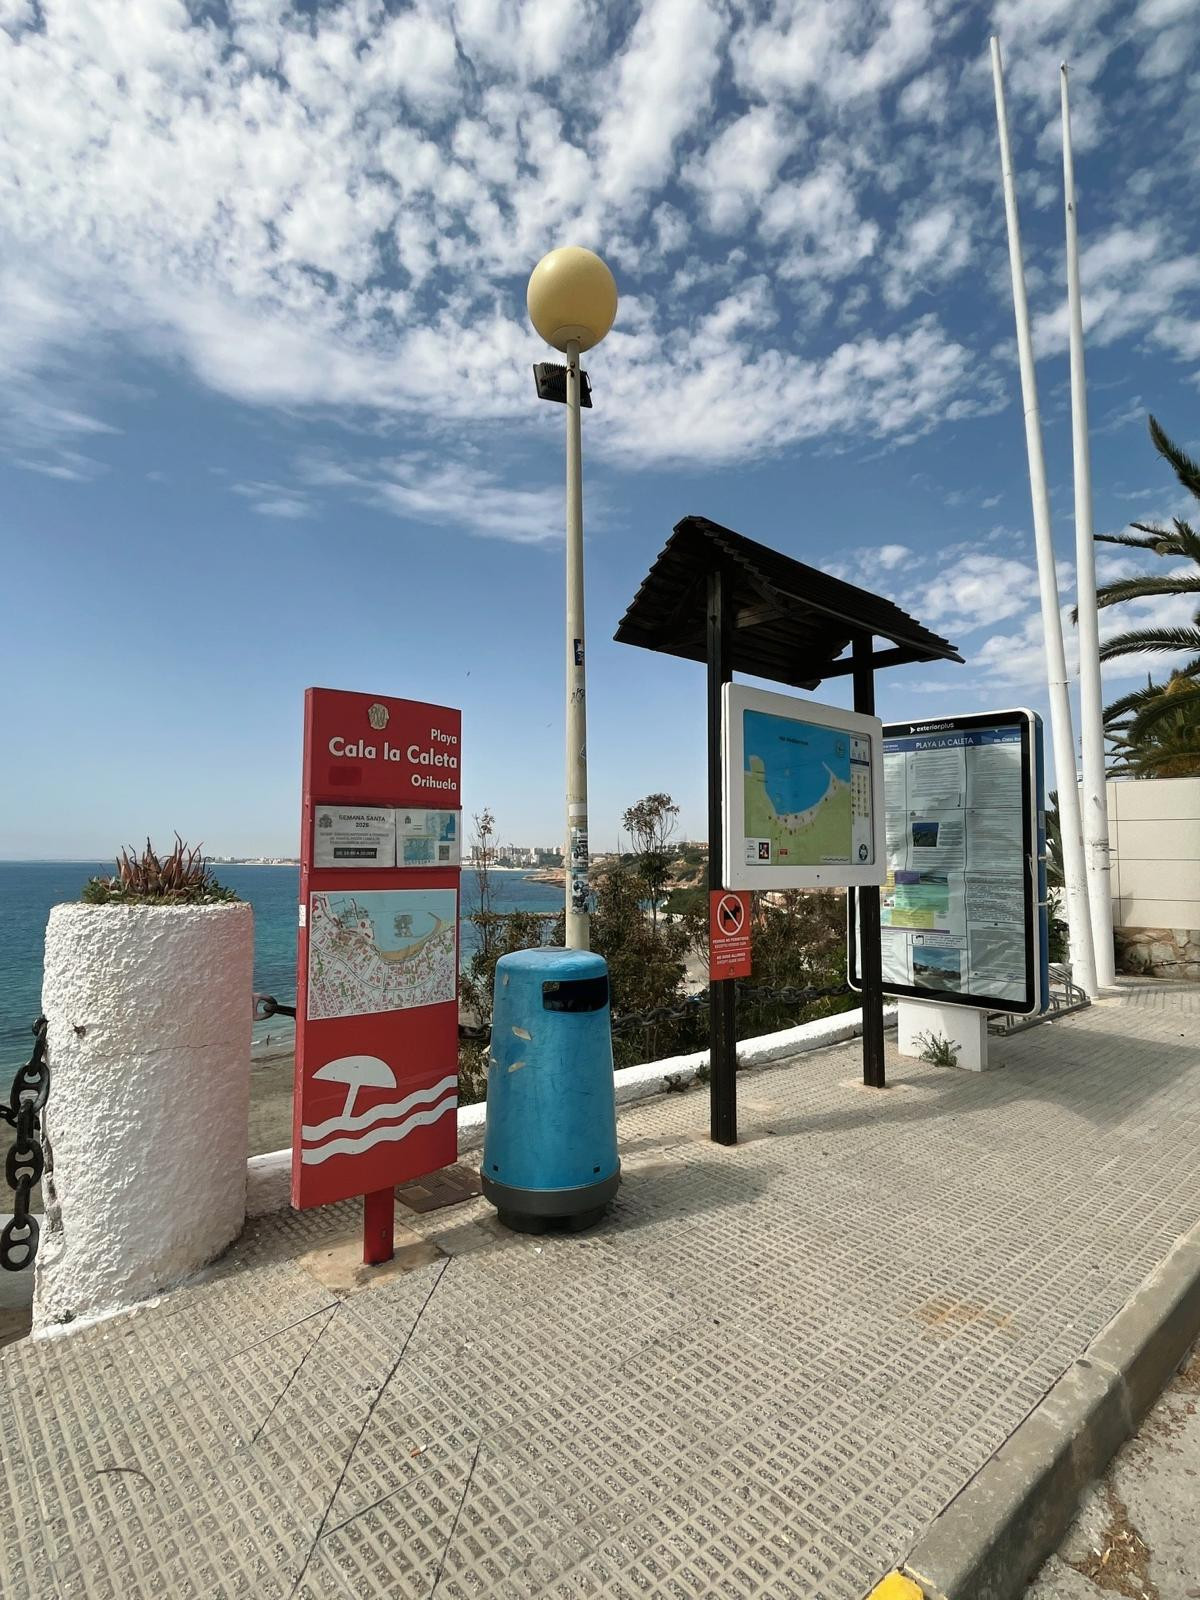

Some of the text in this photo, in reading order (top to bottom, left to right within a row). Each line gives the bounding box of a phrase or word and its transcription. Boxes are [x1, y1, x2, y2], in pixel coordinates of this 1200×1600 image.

[916, 722, 954, 732] exteriorplus
[431, 729, 457, 745] Playa
[916, 741, 937, 749] PLAYA
[948, 737, 974, 746] CALETA
[329, 737, 457, 768] Cala la Caleta
[411, 774, 457, 790] Orihuela
